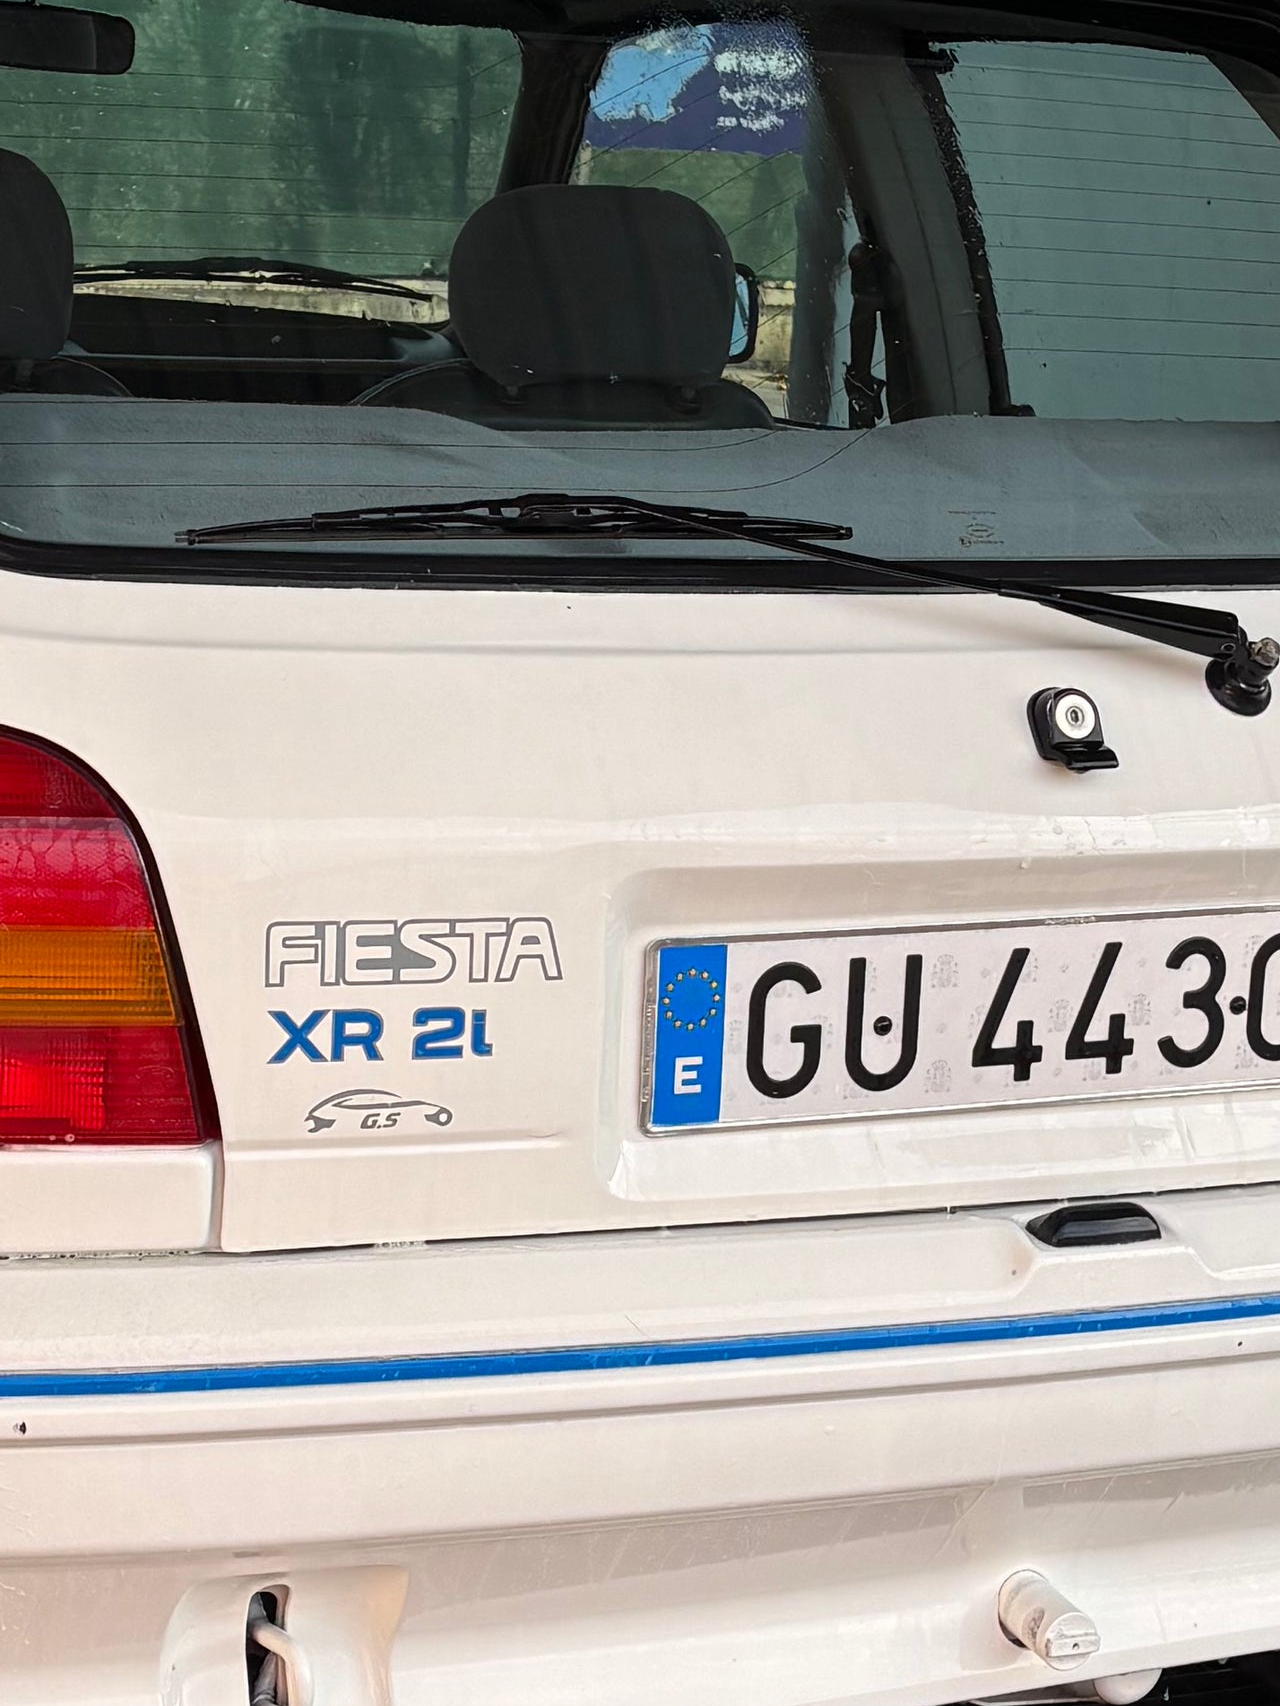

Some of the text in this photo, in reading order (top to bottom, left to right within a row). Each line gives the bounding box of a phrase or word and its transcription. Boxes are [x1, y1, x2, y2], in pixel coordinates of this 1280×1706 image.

[264, 917, 563, 988] FIESTA
[267, 1007, 385, 1065] XR
[745, 953, 924, 1100] GU
[673, 1055, 704, 1095] E
